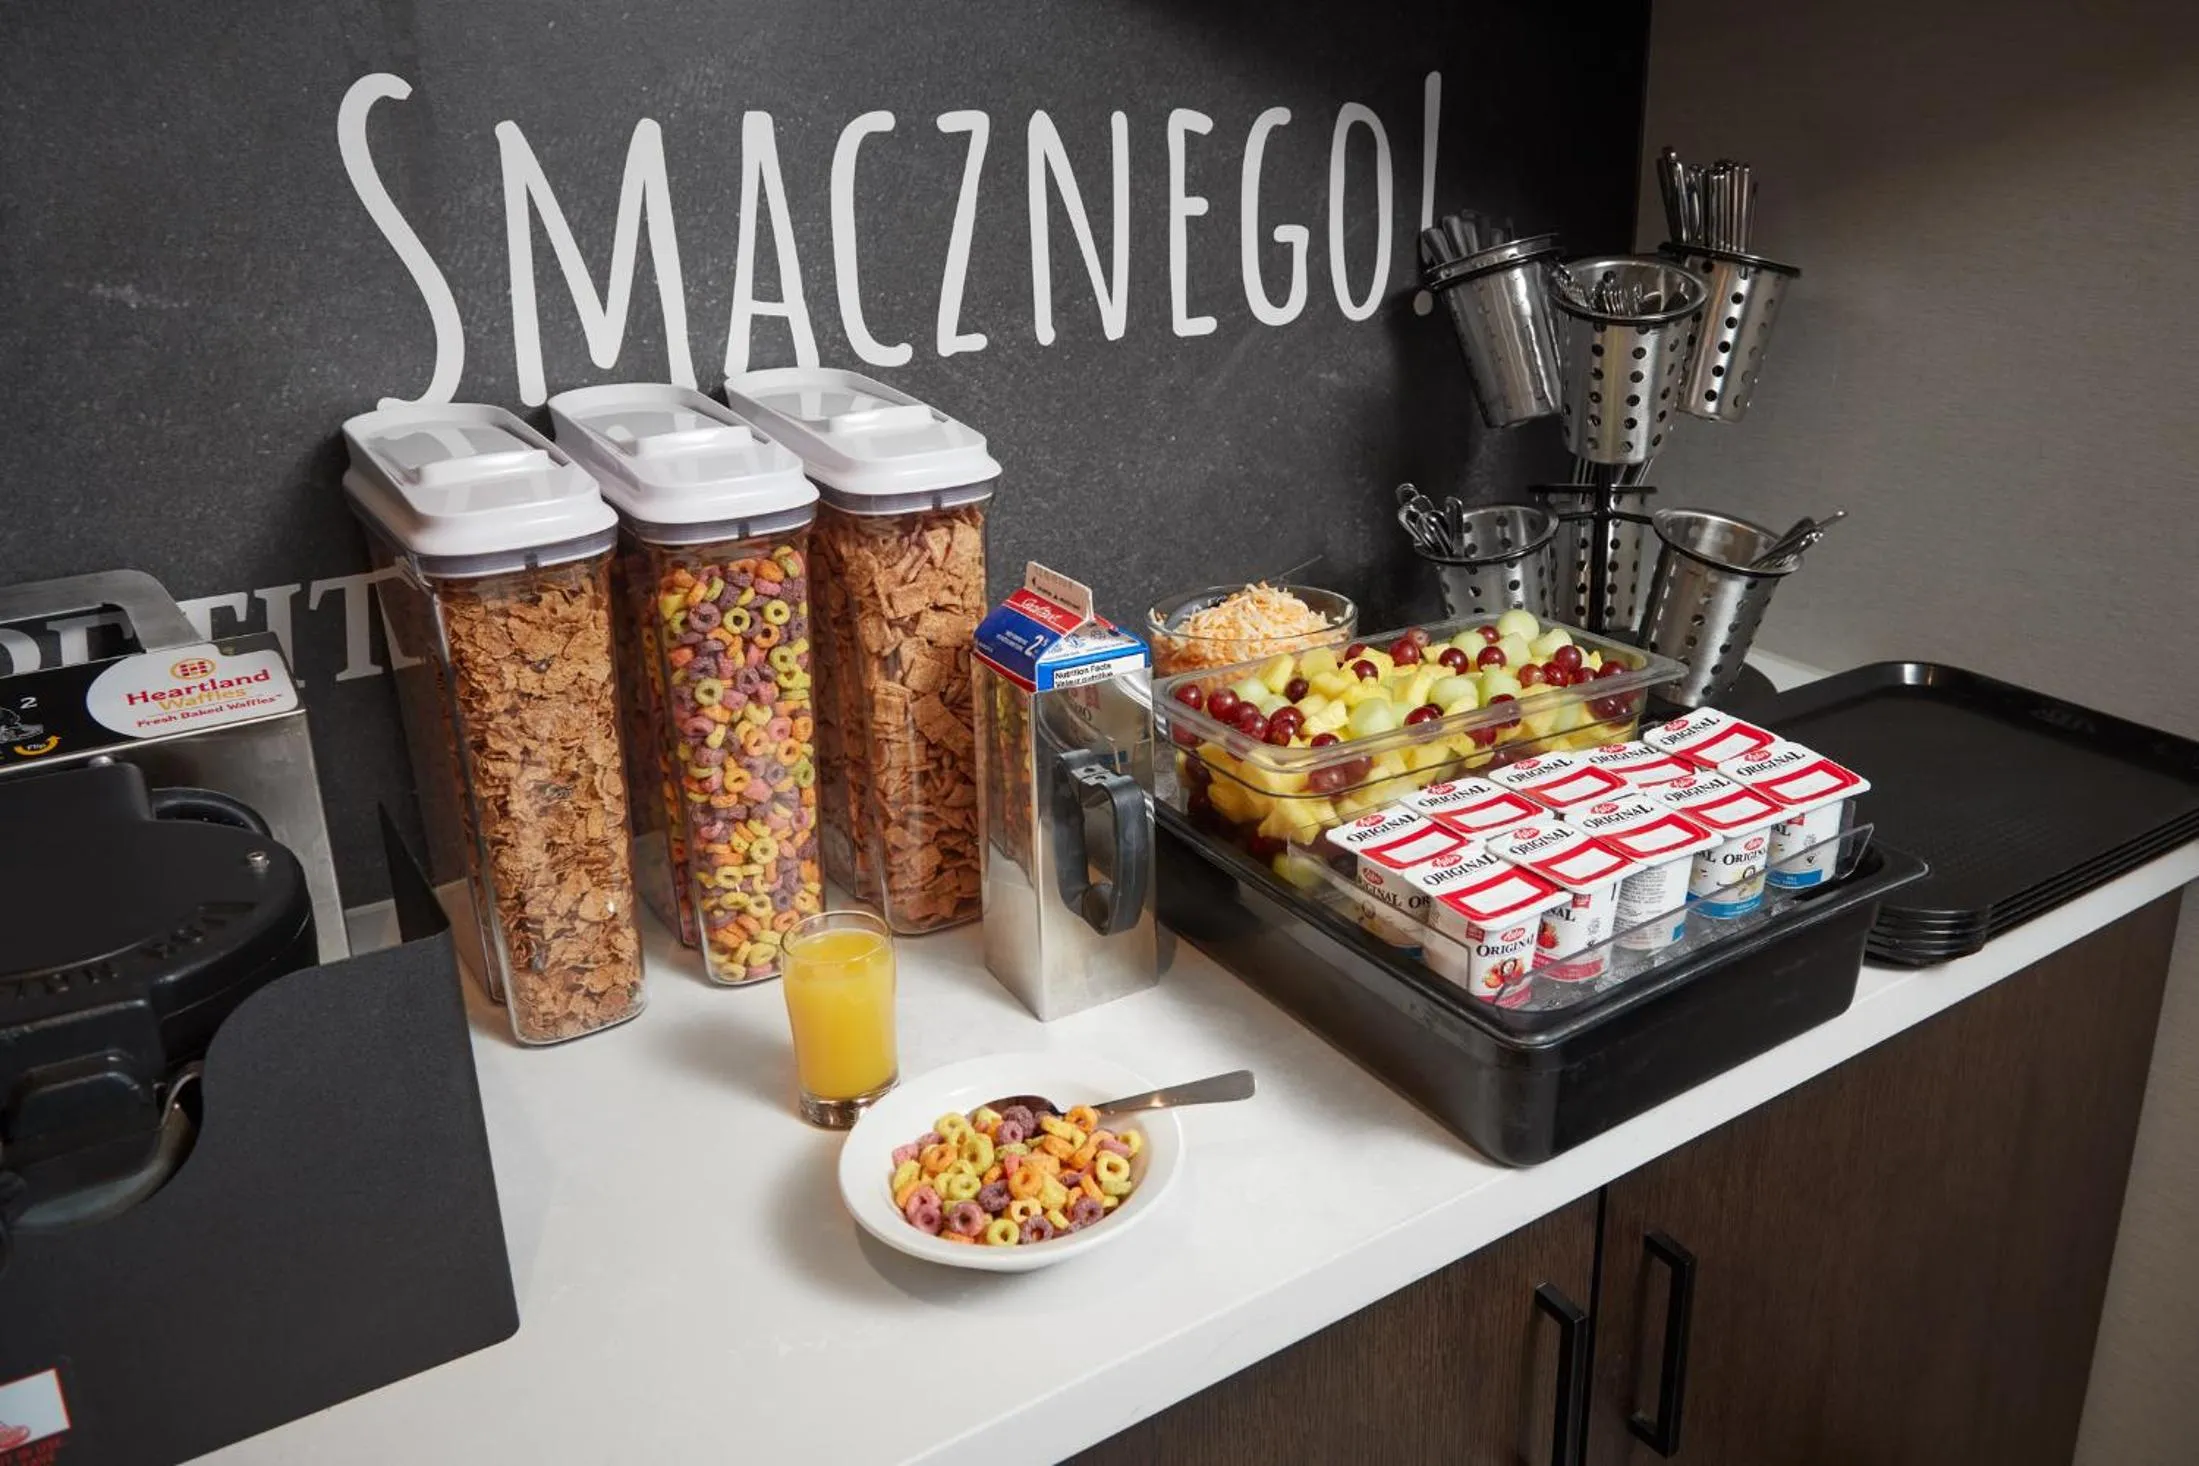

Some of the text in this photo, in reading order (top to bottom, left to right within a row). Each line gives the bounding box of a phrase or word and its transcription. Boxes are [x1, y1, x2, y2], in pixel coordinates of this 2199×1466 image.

[337, 71, 1441, 408] SMACZNEGO!
[1055, 663, 1112, 680] Nutrition Facts
[126, 669, 271, 706] Heartland
[20, 696, 38, 709] 2
[136, 713, 177, 728] Fresh
[180, 706, 224, 720] Baked
[1660, 717, 1721, 745] ORIGINAL
[1507, 759, 1574, 782] ORIGINAL
[1736, 751, 1806, 776] ORIGINAL
[1417, 784, 1491, 807] ORIGINAL
[1664, 778, 1731, 801] ORIGINAL
[1346, 814, 1421, 842] ORIGINAL
[1583, 804, 1654, 829] ORIGINAL
[1509, 828, 1575, 855] ORIGINAL
[1423, 853, 1500, 886] ORIGINAL
